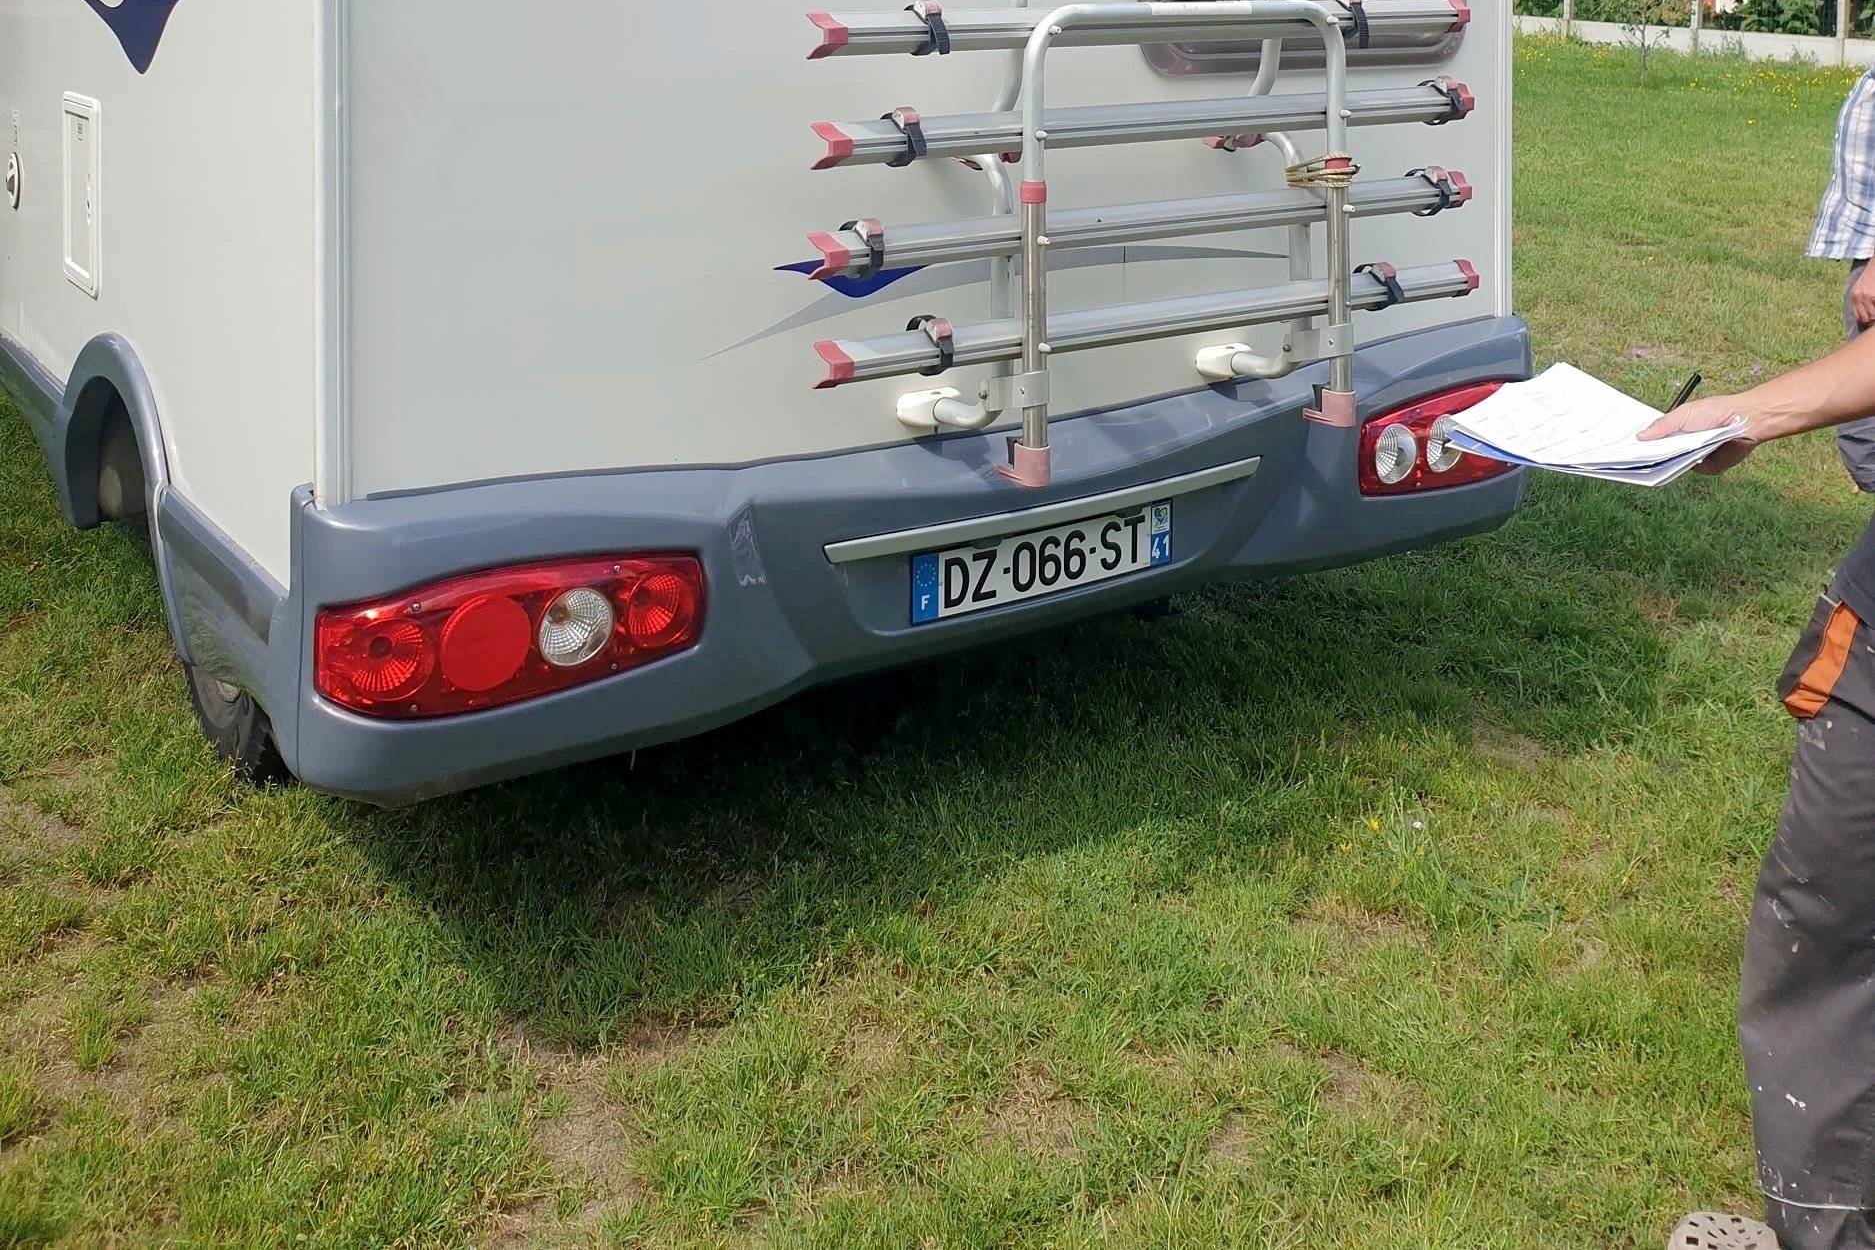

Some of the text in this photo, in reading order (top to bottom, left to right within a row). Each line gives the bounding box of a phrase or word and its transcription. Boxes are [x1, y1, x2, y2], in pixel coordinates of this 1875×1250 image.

[921, 515, 1146, 611] F DZ-066-ST
[1152, 535, 1170, 559] 41
